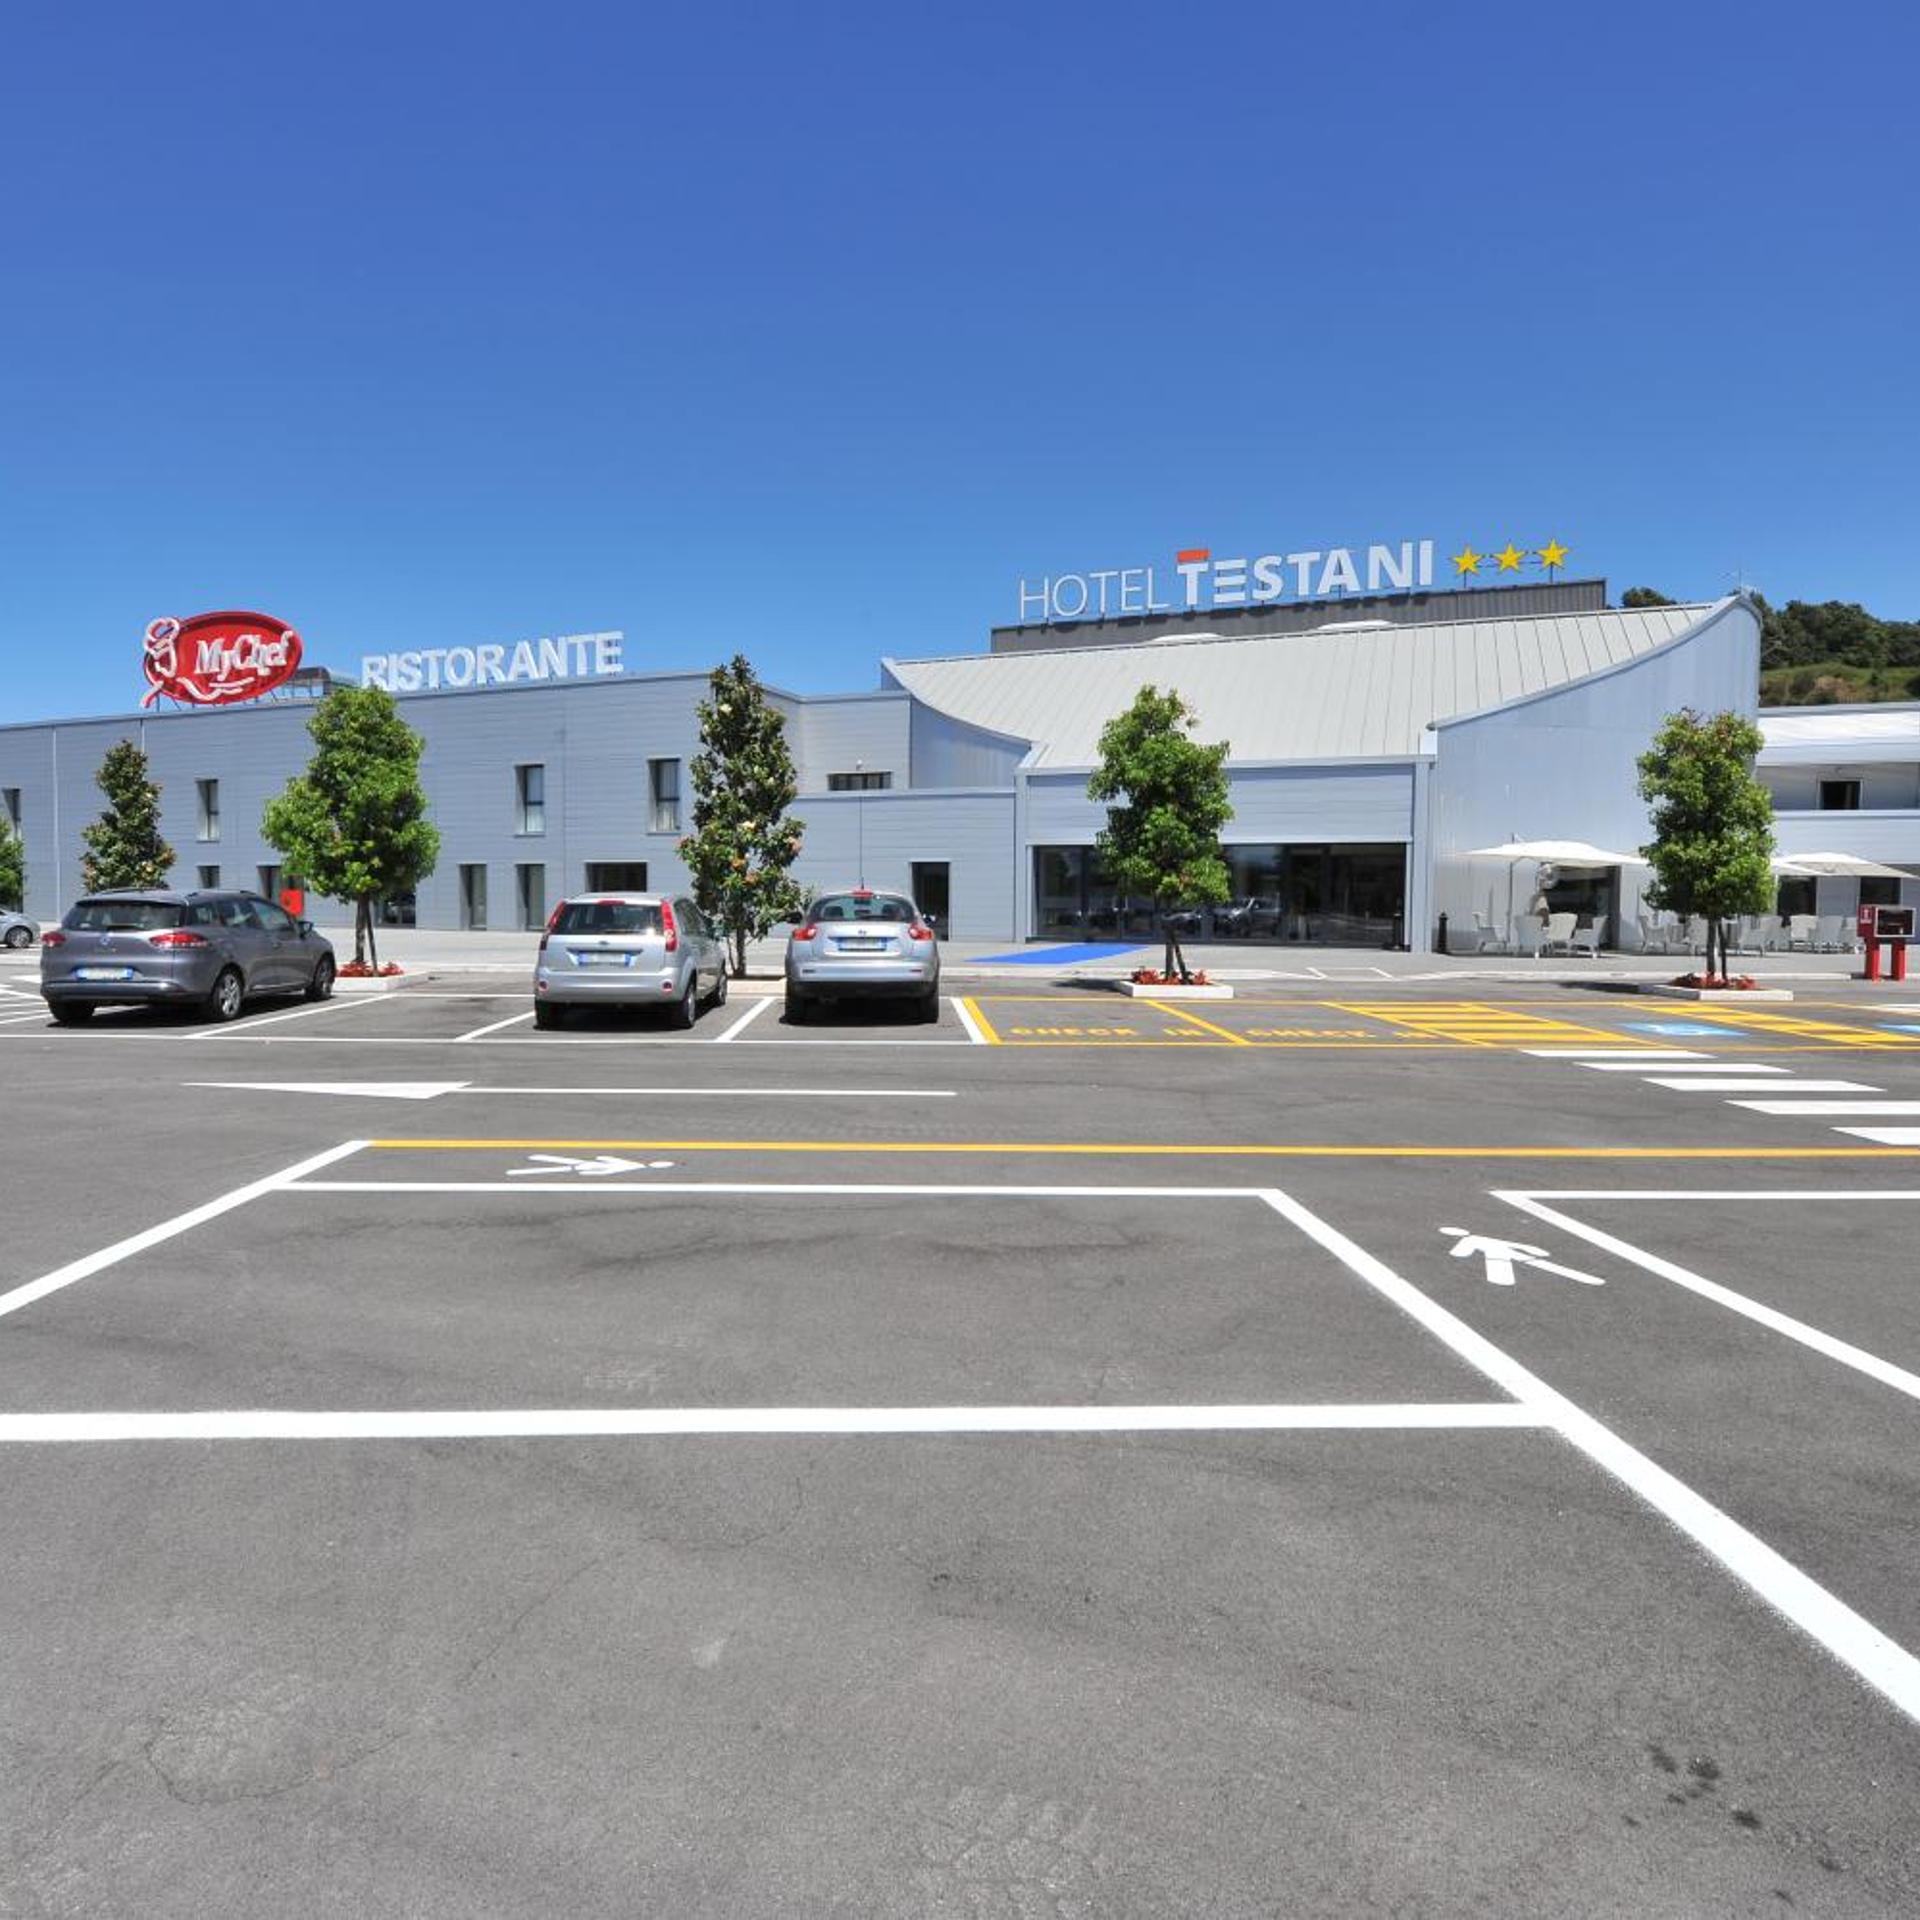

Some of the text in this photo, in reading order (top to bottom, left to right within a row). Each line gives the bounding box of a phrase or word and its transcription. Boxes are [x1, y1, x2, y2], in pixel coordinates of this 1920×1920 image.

[1019, 540, 1434, 620] HOTEL TESTANI
[361, 631, 624, 691] RISTORANTE
